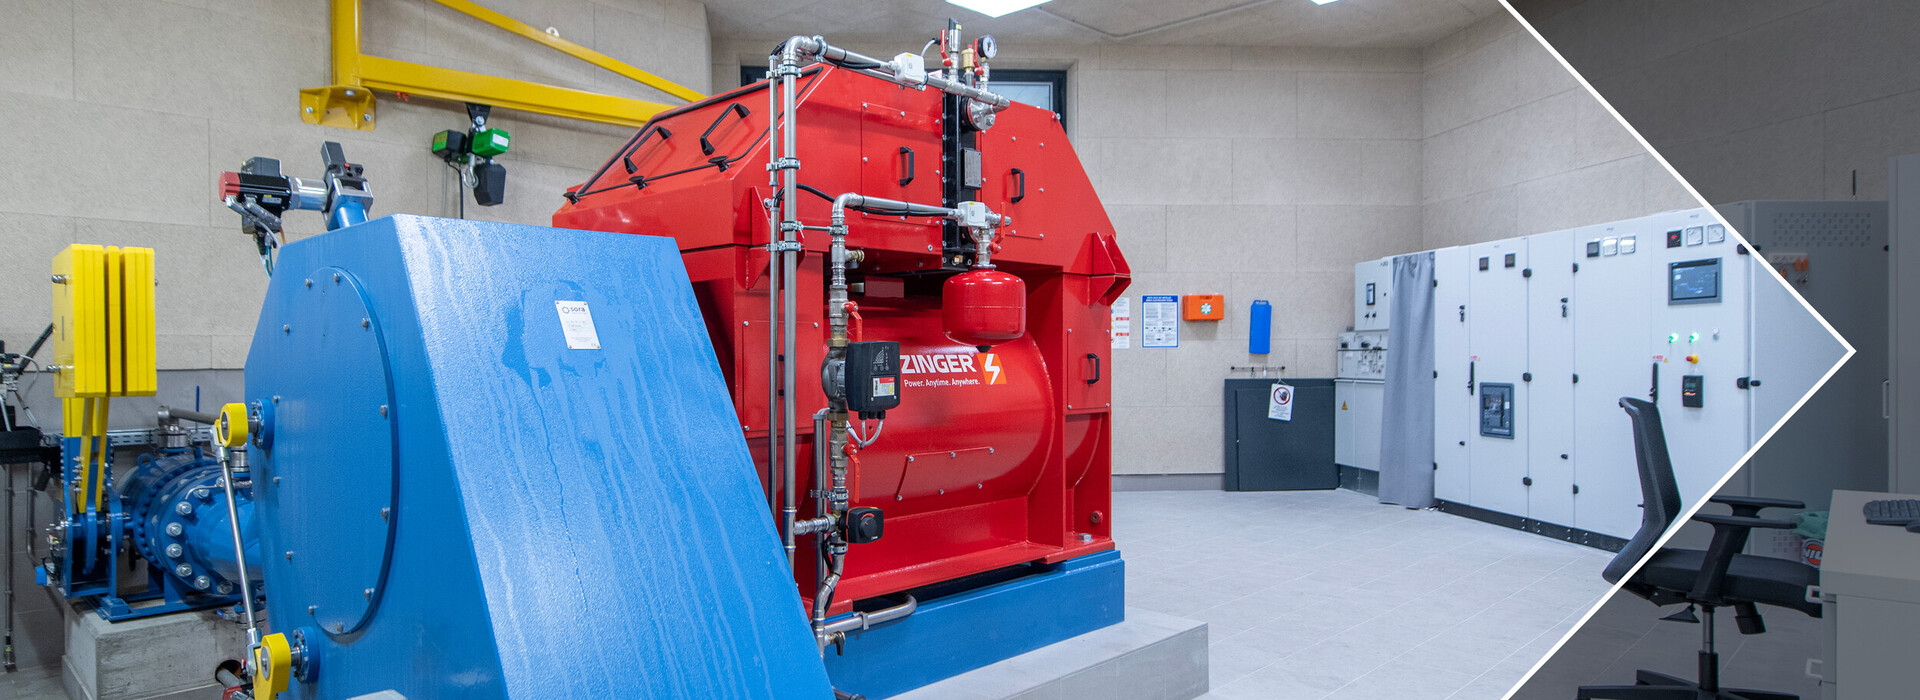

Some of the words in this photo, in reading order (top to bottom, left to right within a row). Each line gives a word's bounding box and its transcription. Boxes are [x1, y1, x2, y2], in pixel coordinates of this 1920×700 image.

[904, 379, 925, 387] Power.
[925, 378, 951, 388] Anytime.
[952, 378, 980, 388] Anywhere.
